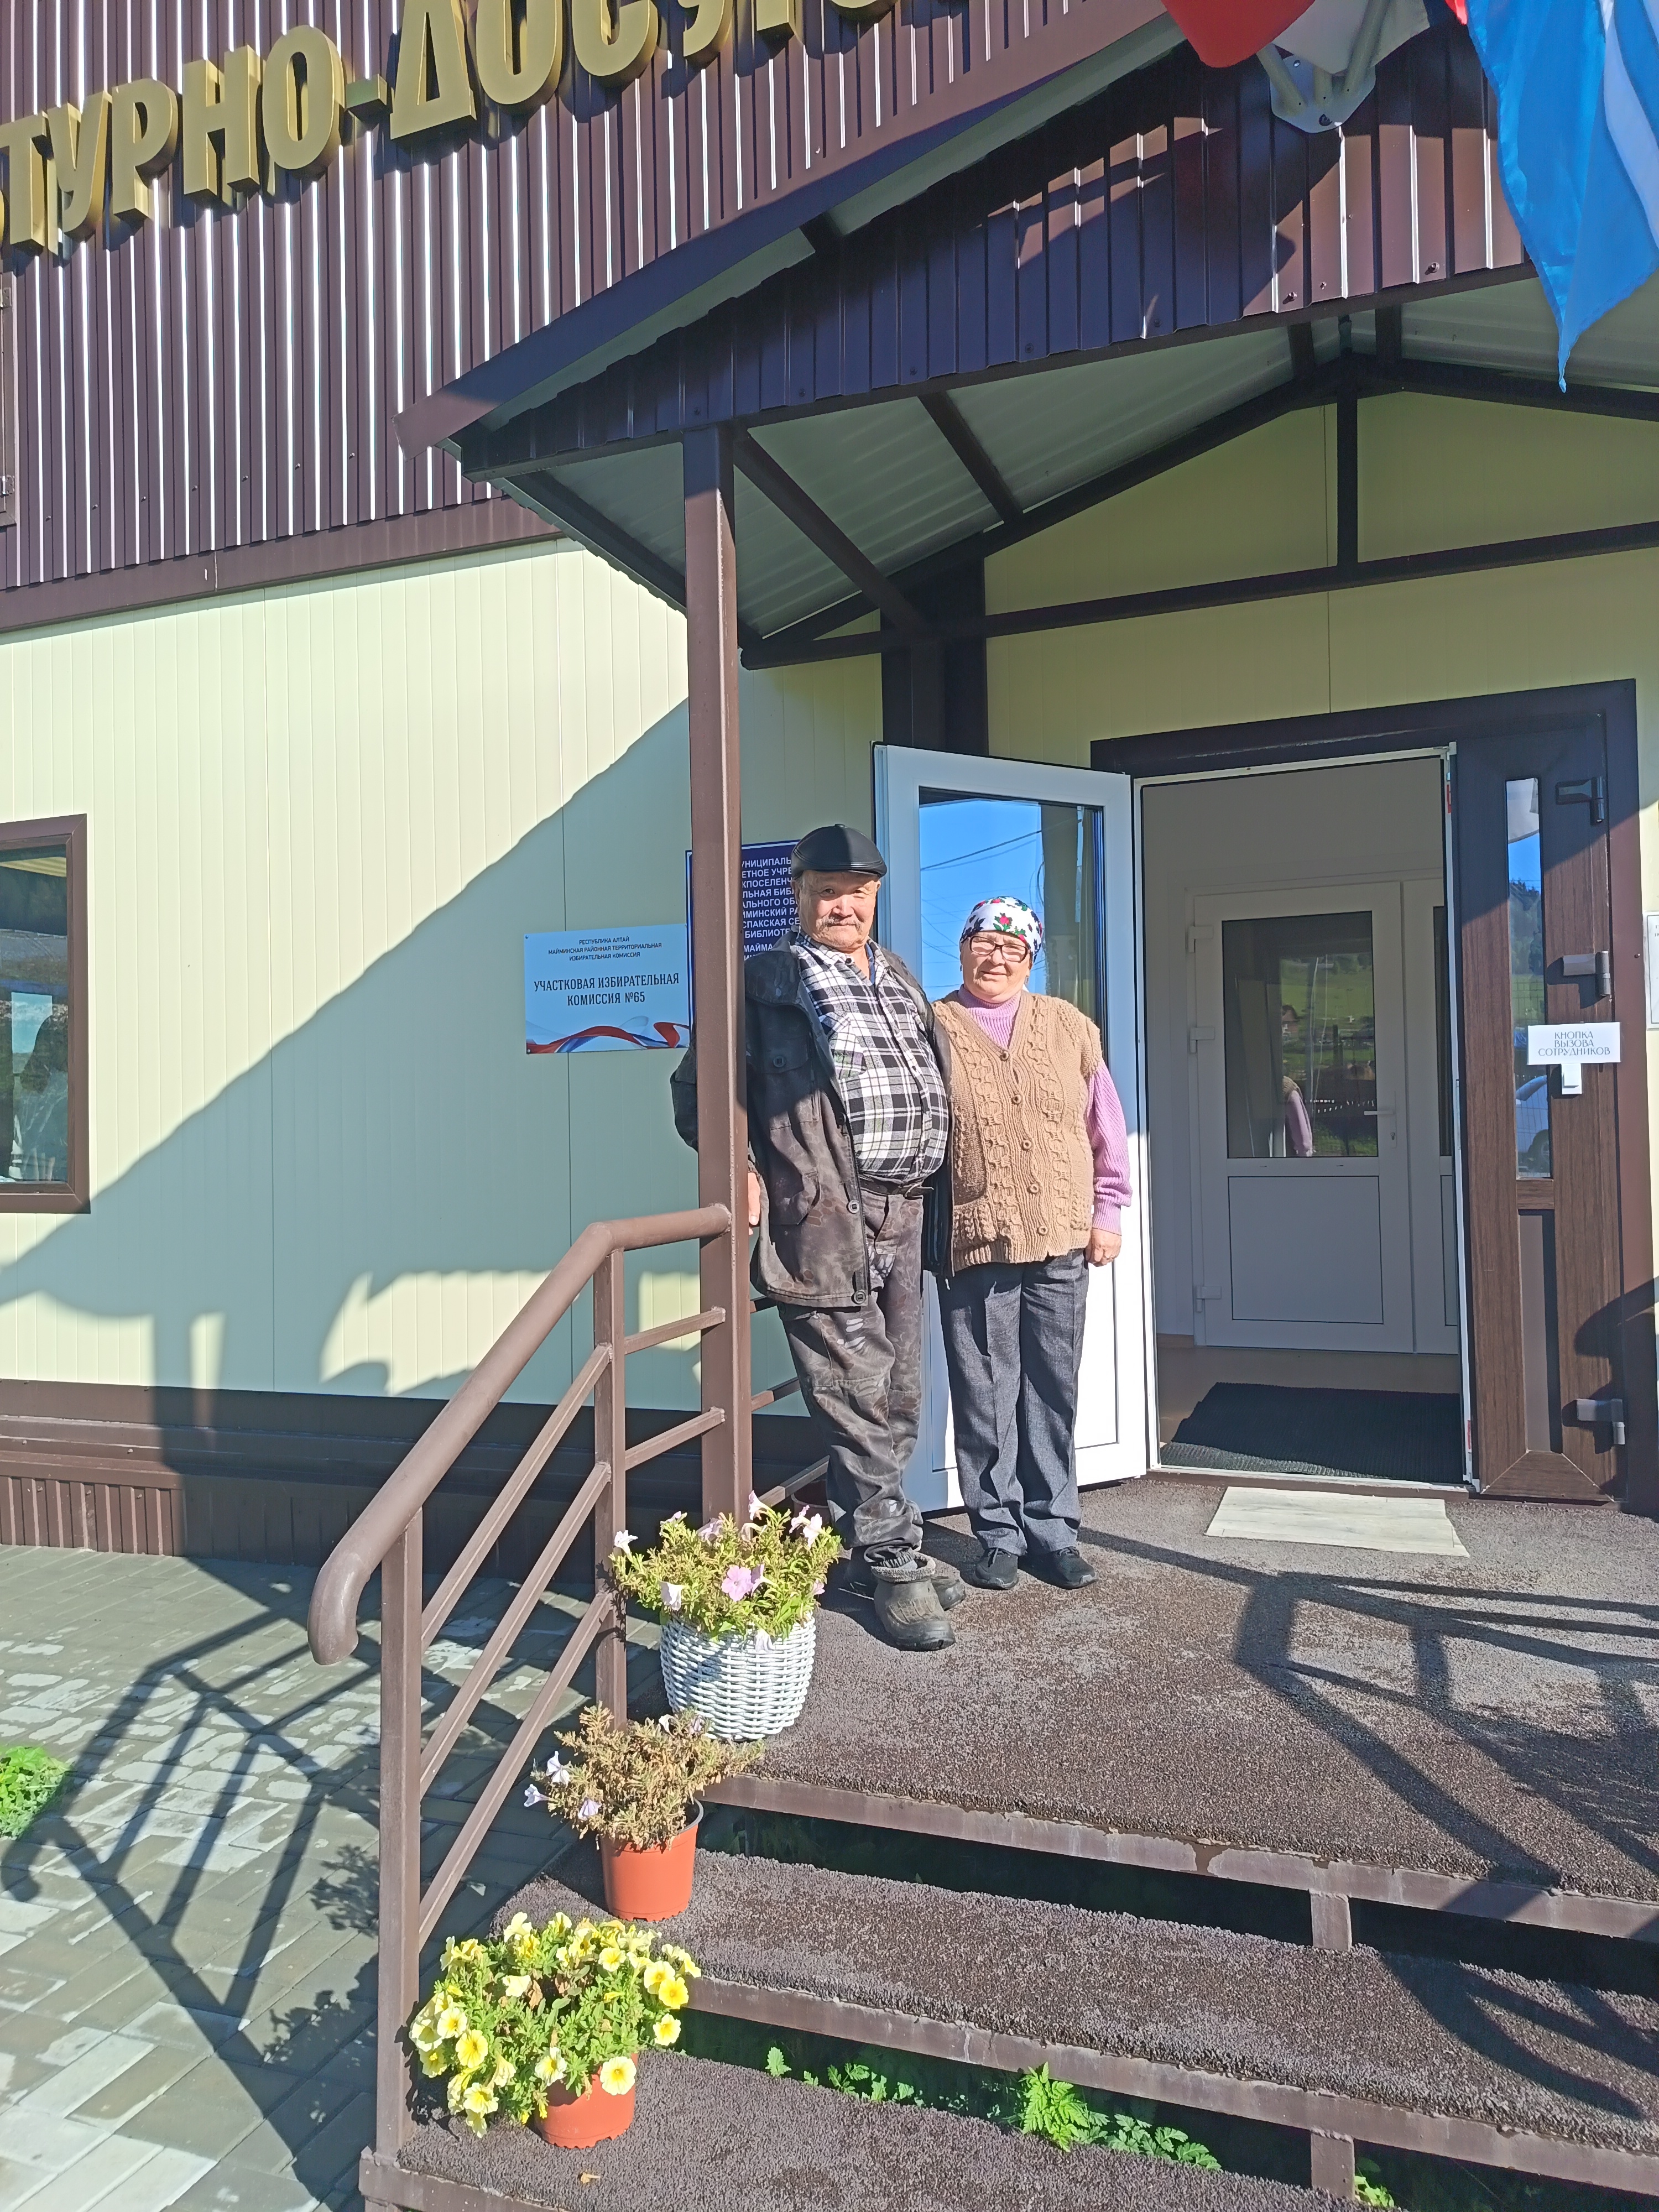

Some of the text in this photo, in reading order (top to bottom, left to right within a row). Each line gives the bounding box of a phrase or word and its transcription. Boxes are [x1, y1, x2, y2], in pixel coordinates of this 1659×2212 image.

[742, 869, 769, 878] ЕТНОЕ
[612, 942, 662, 951] ТЕРРИТОРИАЛЬНАЯ
[534, 973, 680, 992] УЧАСТКОВАЯ ИЗБИРАТЕЛЬНАЯ
[567, 991, 645, 1006] КОМИССИЯ №65
[1554, 1031, 1594, 1040] КНОПКА
[1554, 1039, 1594, 1048] ВЫЗОВА
[1538, 1047, 1610, 1056] СОТРУДНИКОВ
